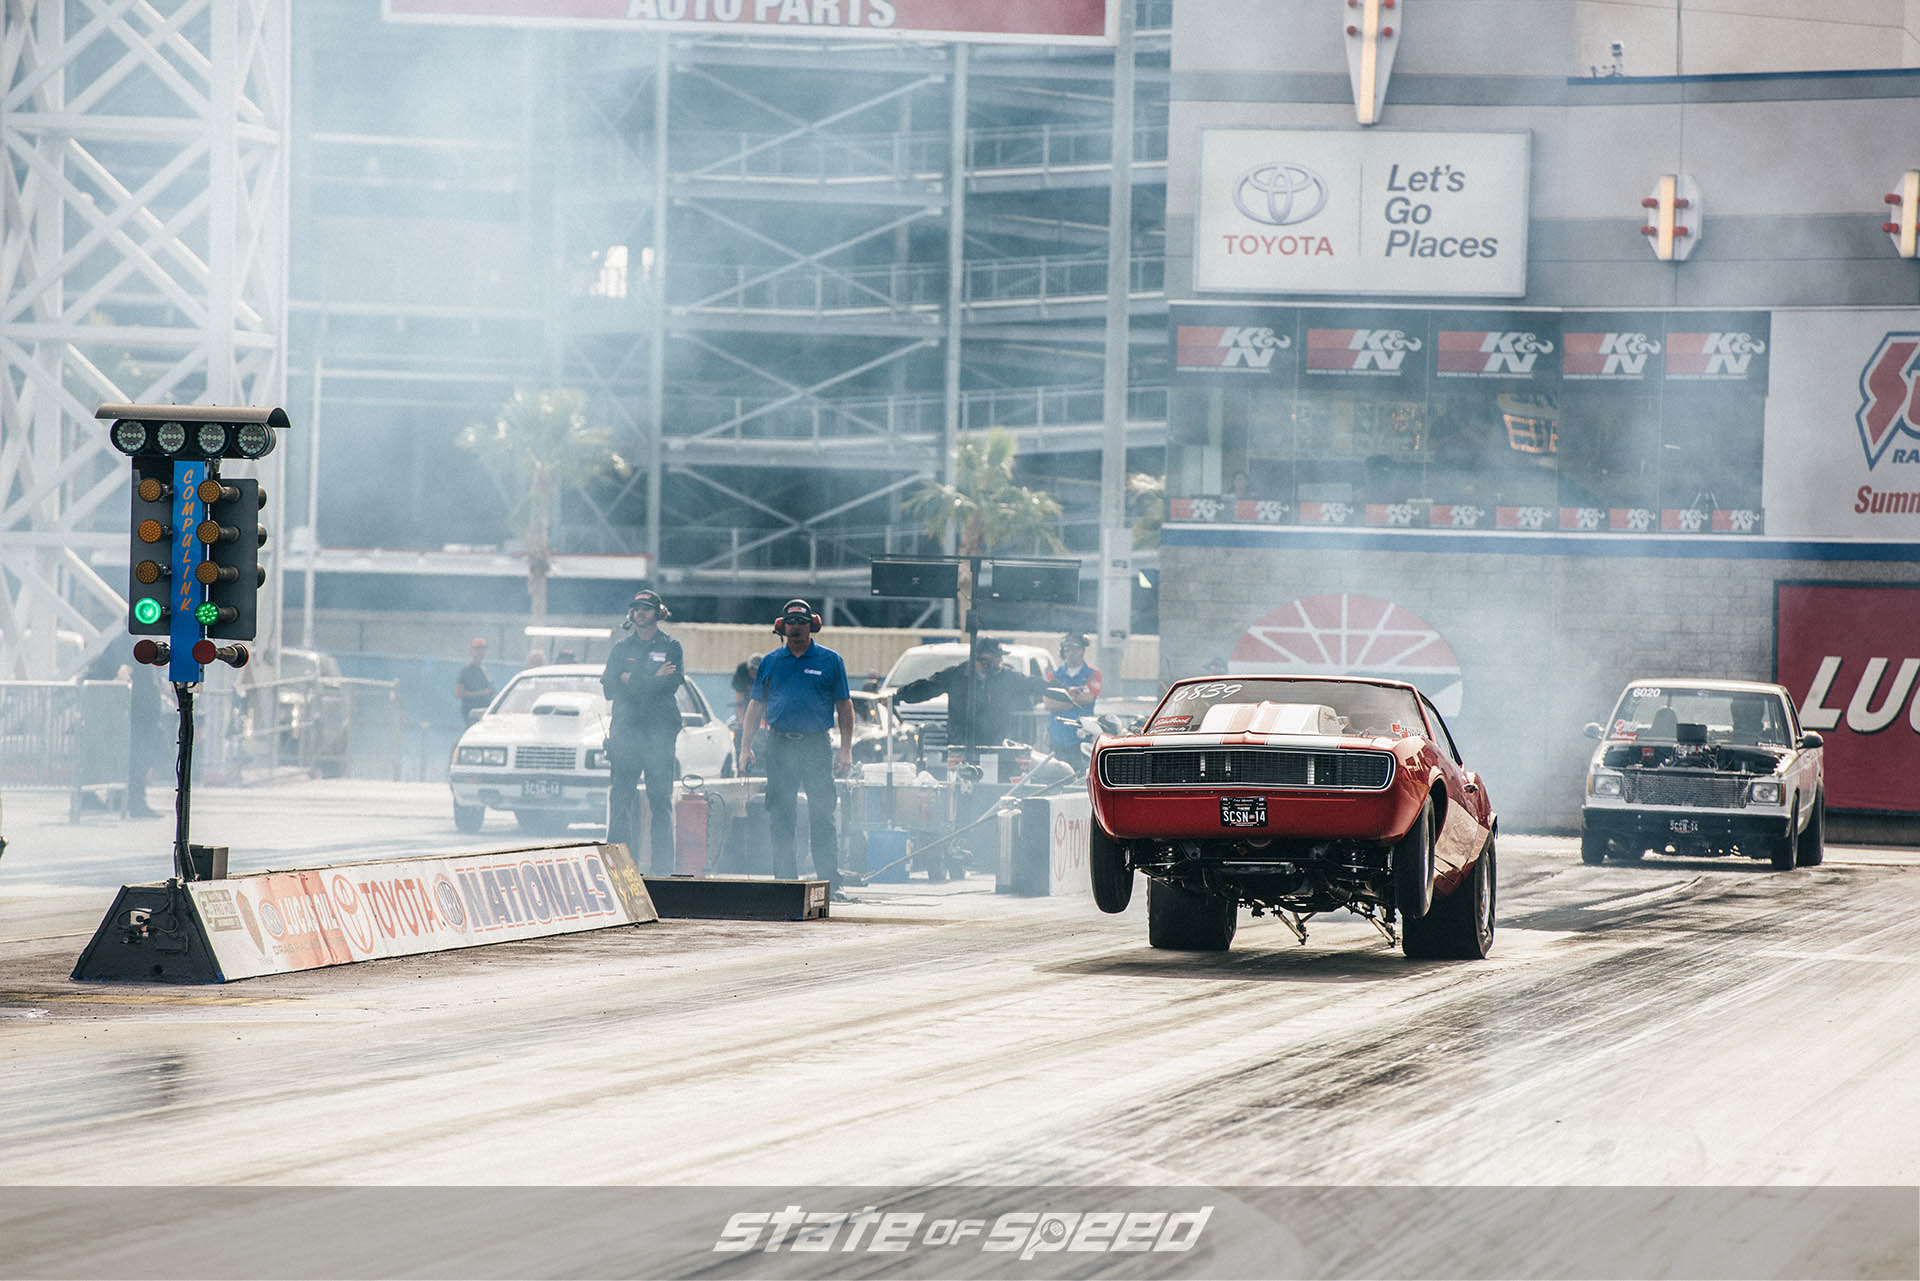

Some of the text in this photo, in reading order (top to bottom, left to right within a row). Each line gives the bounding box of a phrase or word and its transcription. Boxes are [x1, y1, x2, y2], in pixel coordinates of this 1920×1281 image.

[752, 0, 897, 28] PARTS
[1386, 164, 1466, 192] Let's
[1384, 196, 1432, 225] Go
[1222, 235, 1335, 256] TOYOTA
[1384, 230, 1498, 259] Places
[1217, 326, 1291, 367] K&N
[1347, 329, 1422, 370] K&N
[1479, 332, 1554, 373] K&N
[1599, 333, 1661, 375] K&N
[1702, 333, 1765, 375] K&N
[180, 469, 194, 612] COMPULINK
[1173, 683, 1243, 701] 6839
[1632, 688, 1661, 697] 6020
[1799, 656, 1920, 733] LU
[1223, 811, 1266, 822] SCSN-14
[278, 894, 321, 936] LUCAS
[312, 892, 341, 931] OIL
[359, 877, 441, 939] TOYOTA
[455, 854, 616, 933] NATIONALS
